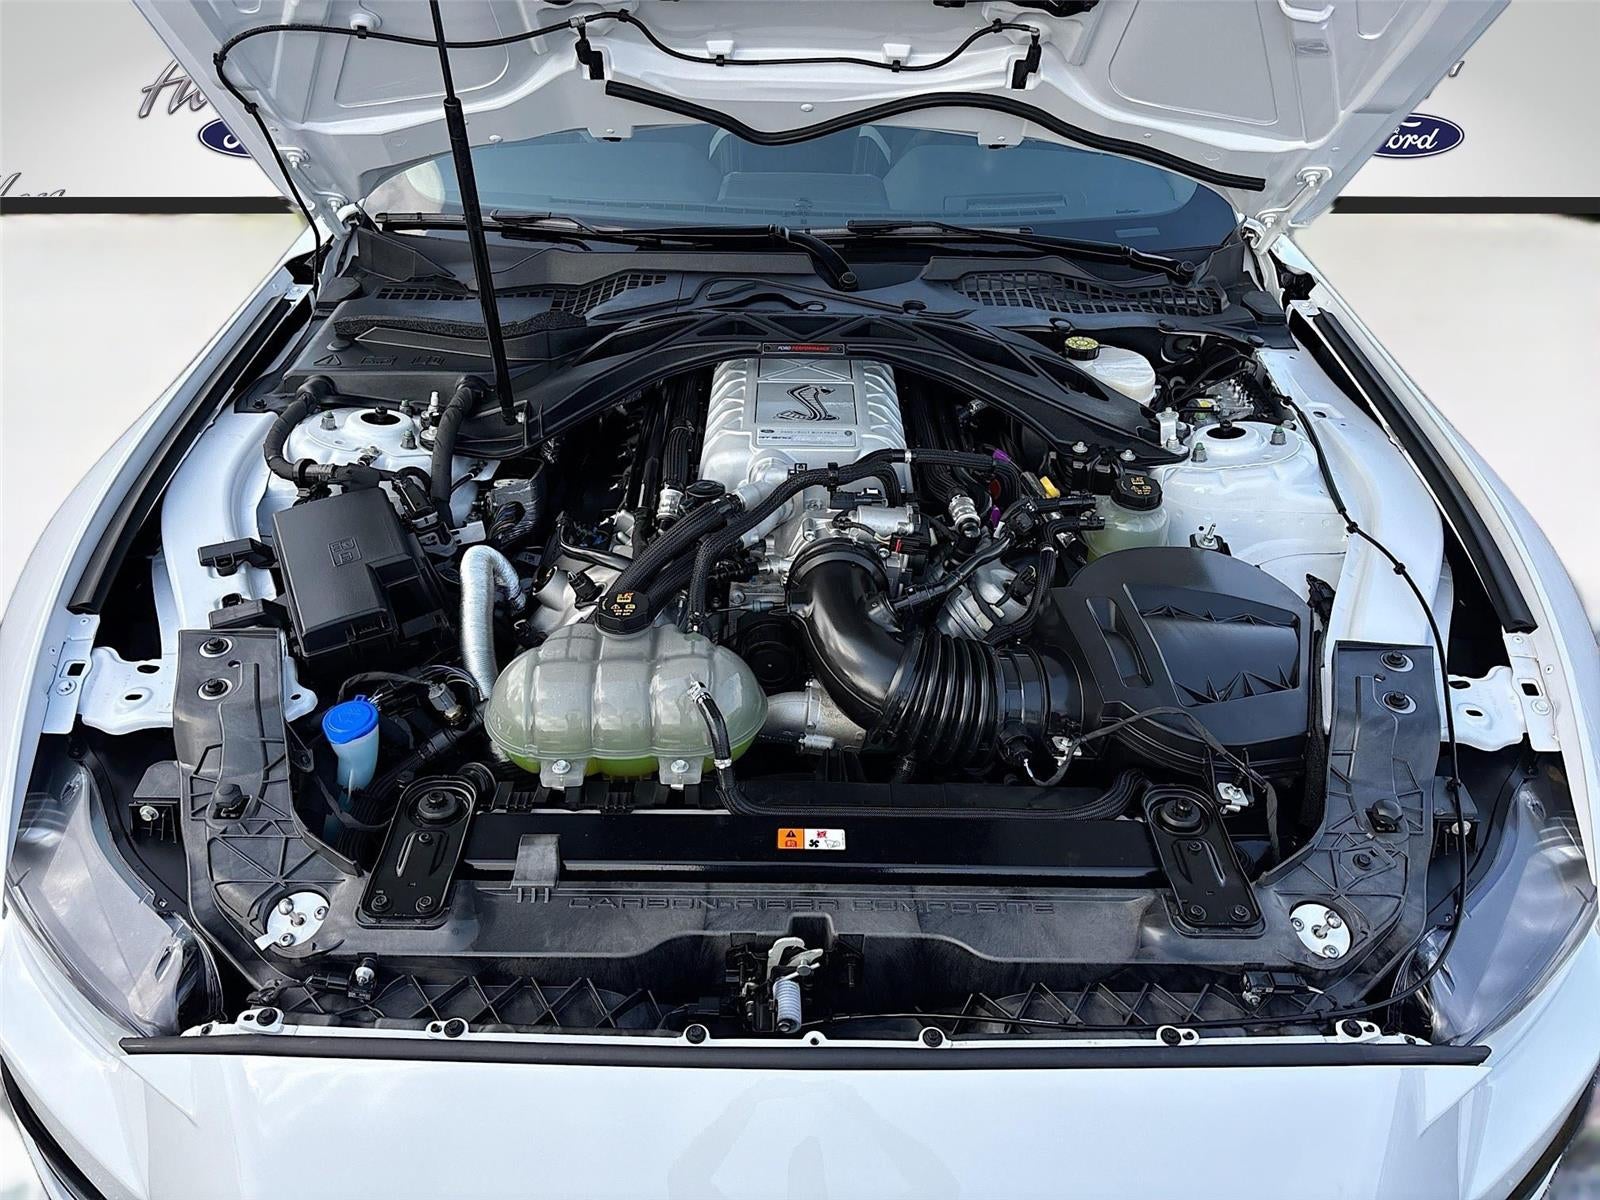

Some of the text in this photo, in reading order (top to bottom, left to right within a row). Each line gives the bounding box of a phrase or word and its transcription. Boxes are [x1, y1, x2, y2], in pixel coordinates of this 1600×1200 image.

[1386, 121, 1440, 150] ord
[792, 344, 833, 352] PERFORMANCE
[850, 898, 1056, 914] COMPOSITE
